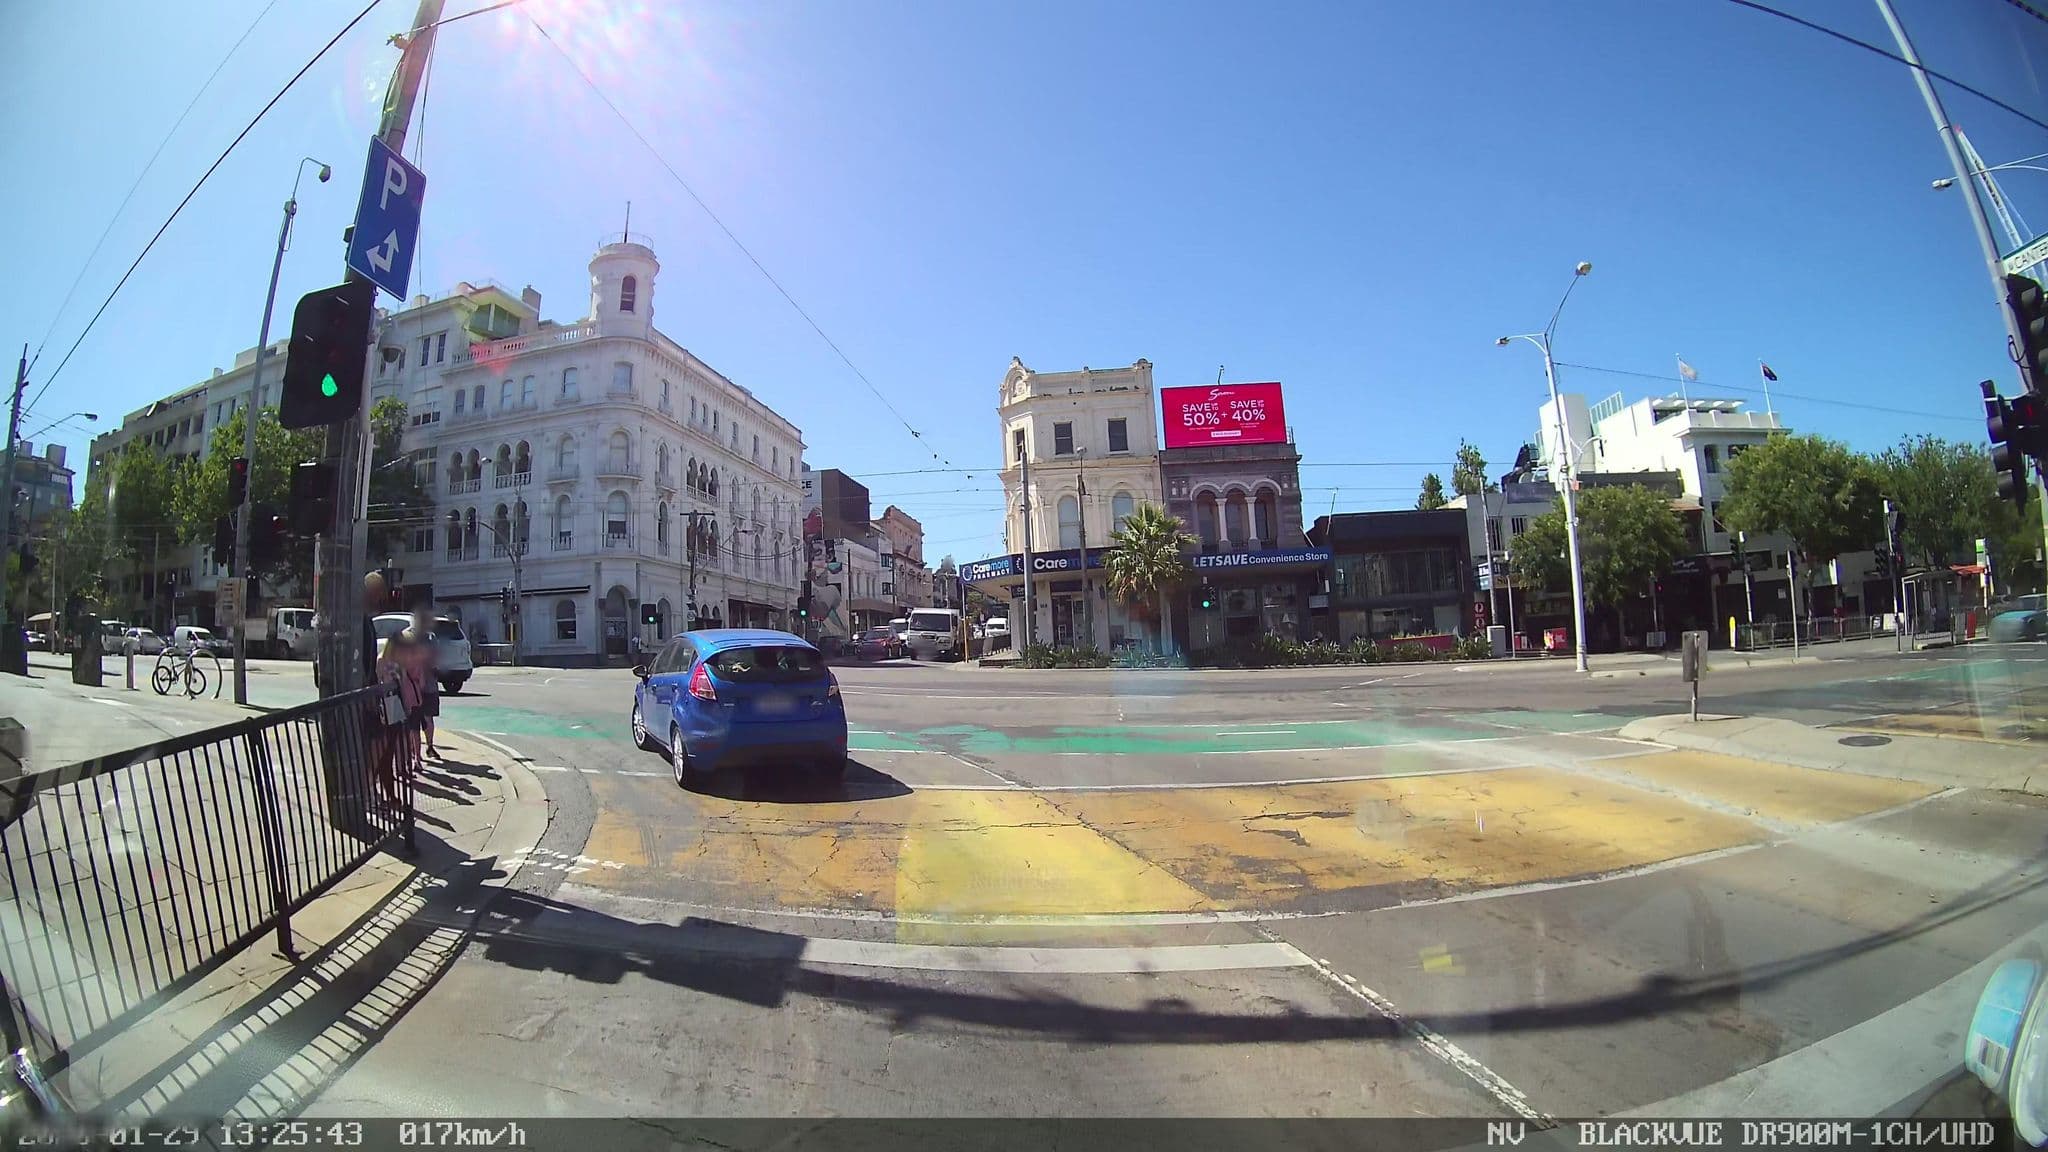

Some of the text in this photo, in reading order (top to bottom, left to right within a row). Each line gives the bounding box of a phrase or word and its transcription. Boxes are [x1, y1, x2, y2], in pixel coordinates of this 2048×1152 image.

[379, 156, 407, 211] P
[1182, 403, 1211, 412] SAVE
[1230, 399, 1256, 409] SAVE
[1183, 412, 1220, 425] 50%
[1232, 409, 1266, 421] 40%
[972, 559, 1010, 574] Caremore
[1192, 552, 1329, 568] LETSAVE Convenience Store
[973, 567, 1011, 581] PHARMACY
